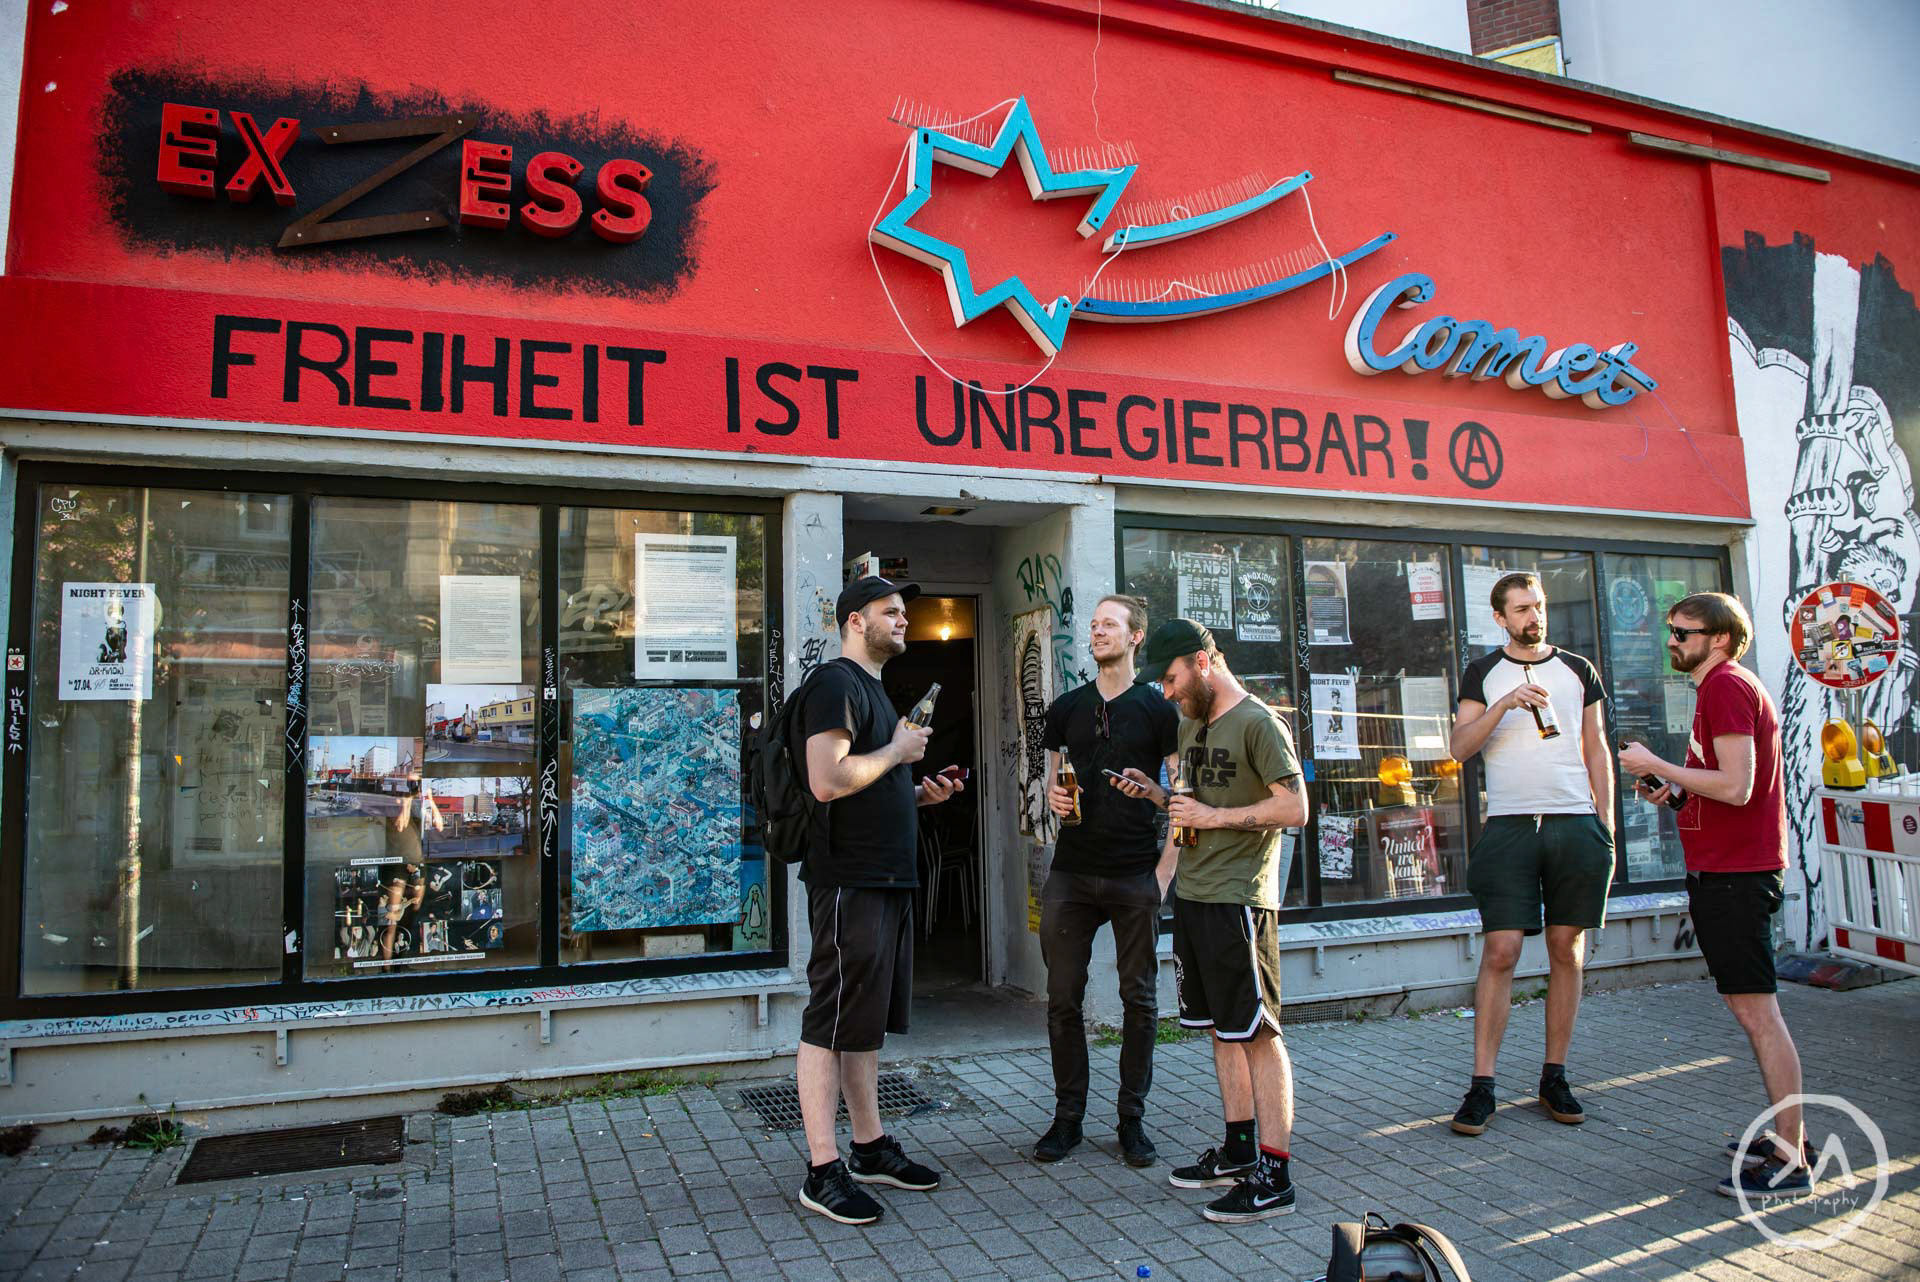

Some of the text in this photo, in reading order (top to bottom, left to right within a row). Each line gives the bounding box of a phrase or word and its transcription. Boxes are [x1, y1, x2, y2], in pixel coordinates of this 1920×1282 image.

[157, 102, 653, 248] EXZESS
[210, 314, 667, 426] FREIHEIT
[725, 356, 859, 440] IST
[1343, 272, 1659, 410] Comet
[70, 588, 146, 598] NIGHT FEVER
[43, 1016, 113, 1031] OPTION!
[119, 1016, 159, 1027] 11.10.
[166, 1012, 213, 1024] DEMO
